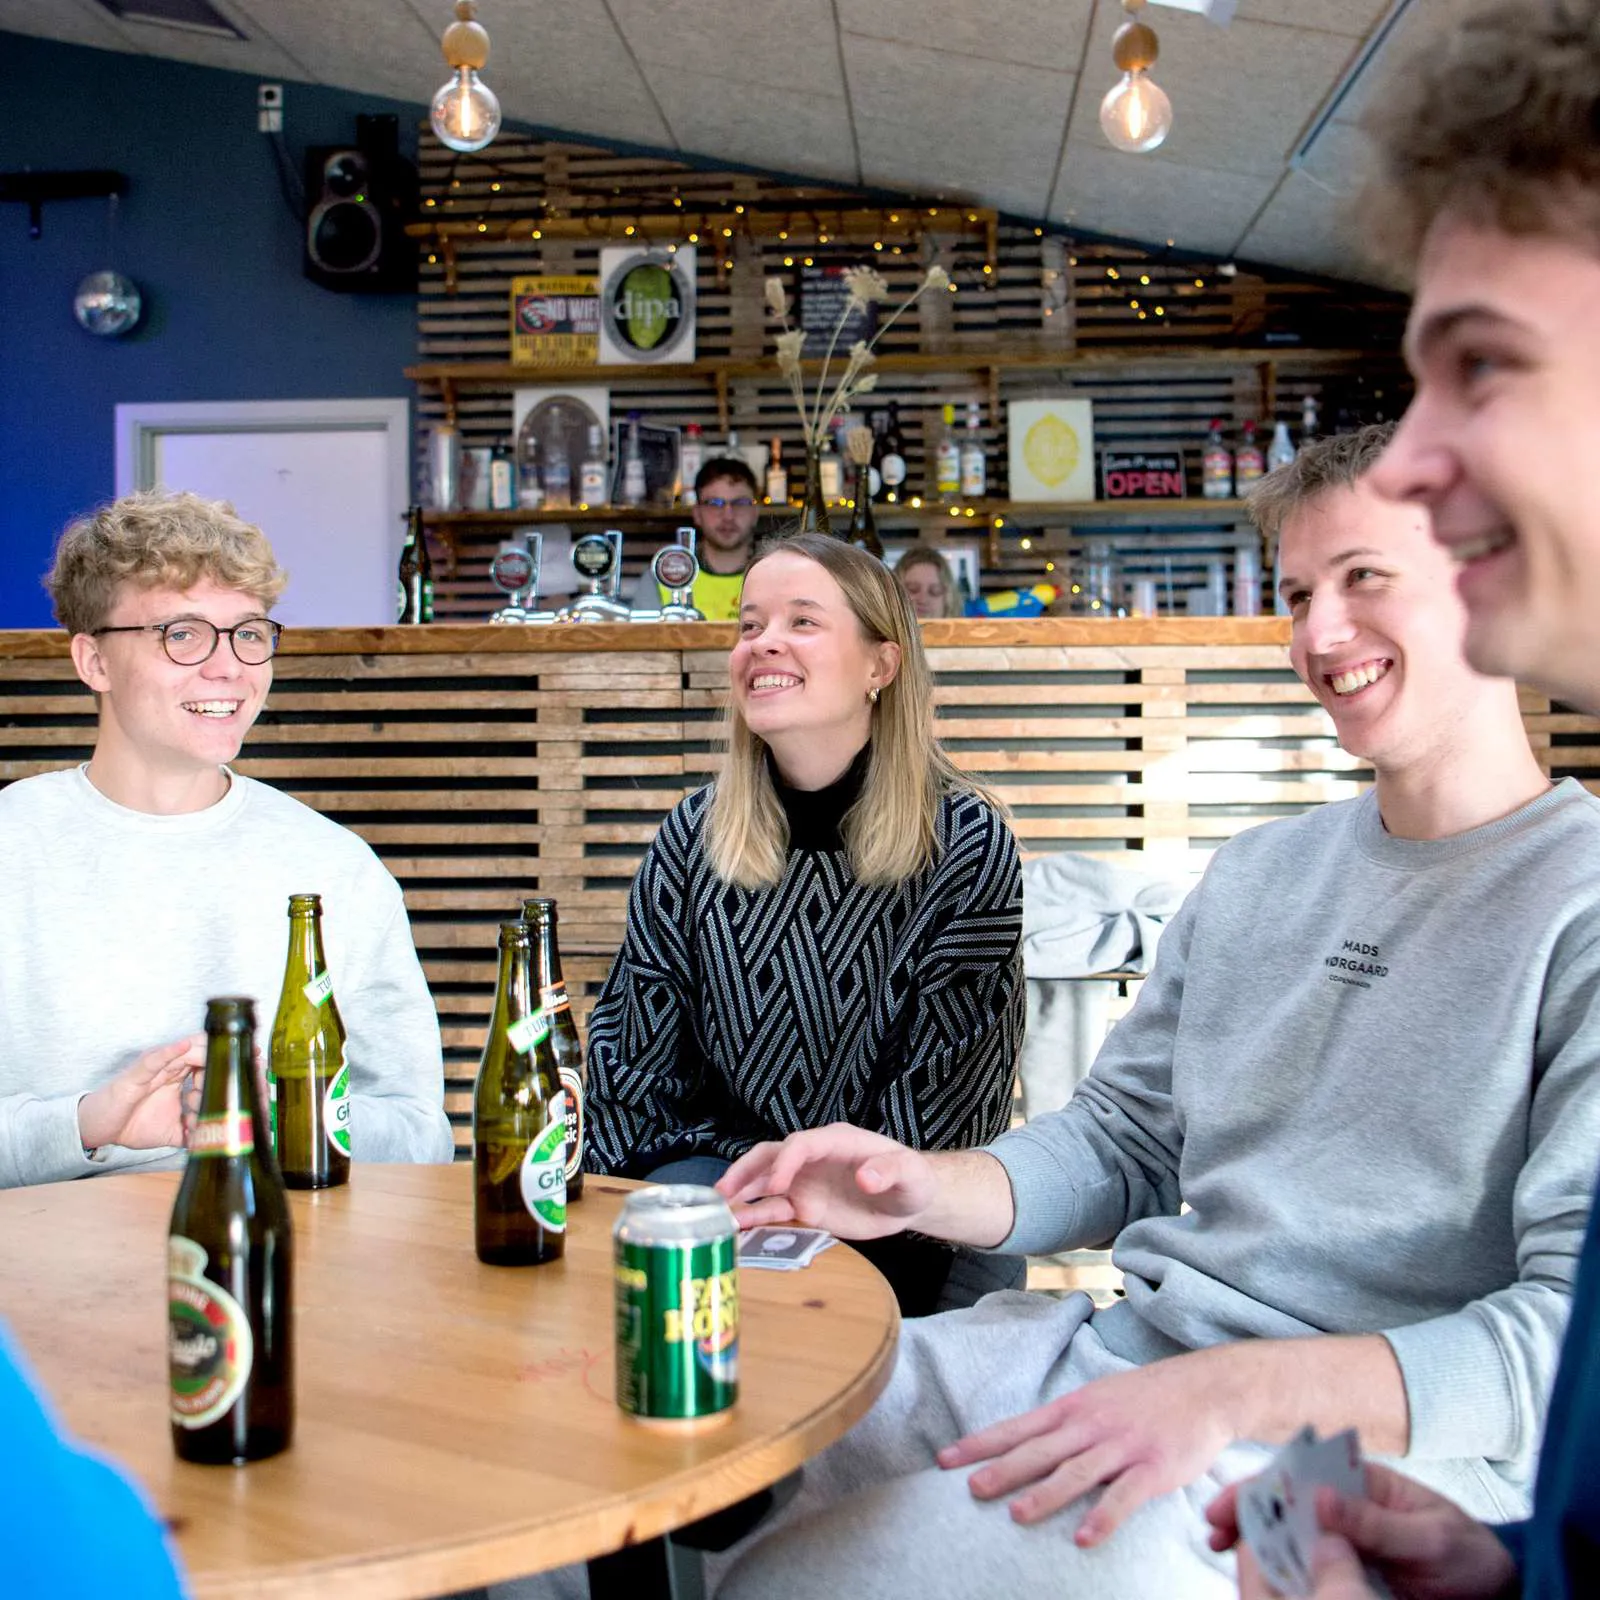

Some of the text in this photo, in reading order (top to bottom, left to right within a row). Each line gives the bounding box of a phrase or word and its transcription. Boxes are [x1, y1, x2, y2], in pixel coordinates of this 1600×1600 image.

[614, 289, 681, 326] dipa
[1105, 472, 1182, 496] OPEN
[1342, 940, 1379, 957] MADS
